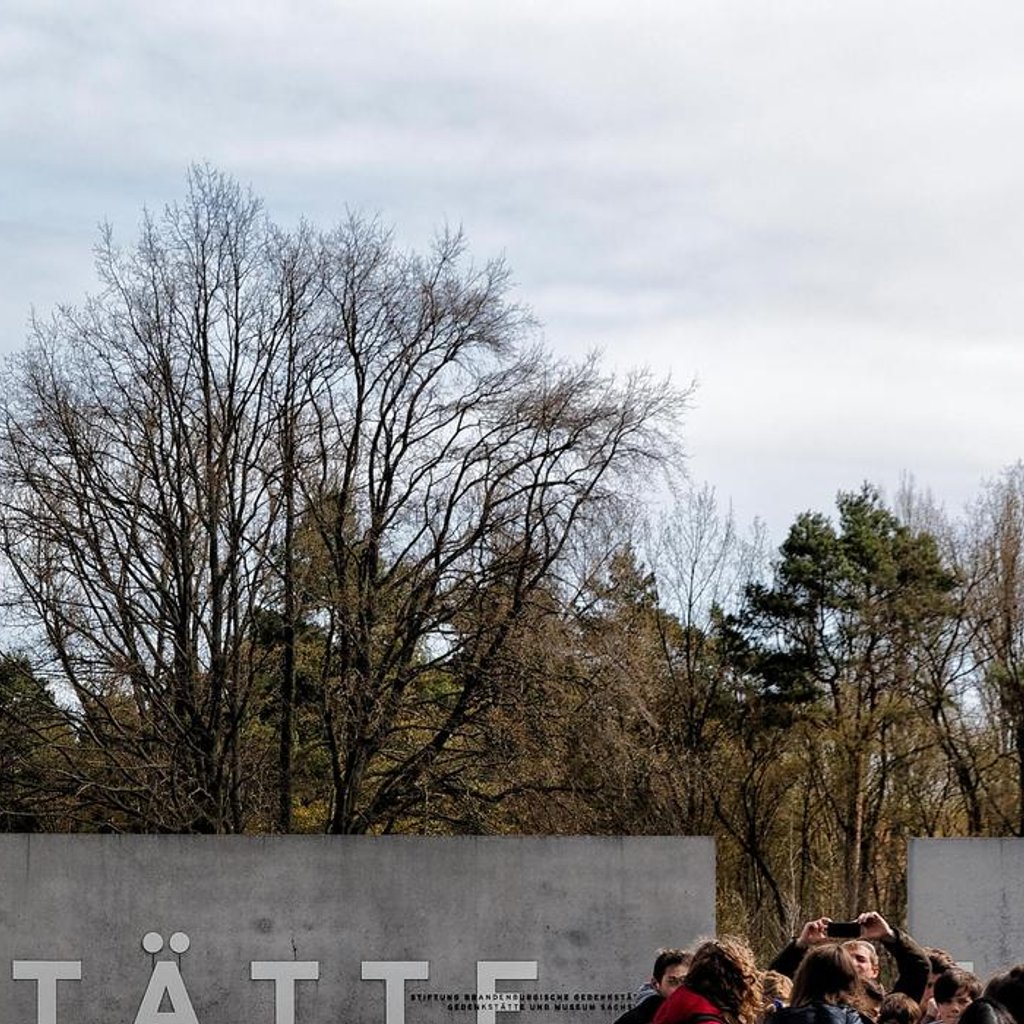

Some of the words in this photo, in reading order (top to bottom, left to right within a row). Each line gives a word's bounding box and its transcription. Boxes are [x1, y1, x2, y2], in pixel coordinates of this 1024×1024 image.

[410, 993, 460, 1001] STIFTUNG
[463, 993, 569, 1001] BRANDENBURGISCHE
[447, 1002, 526, 1011] GEDENKSTÄTTE
[529, 1003, 550, 1011] UND
[554, 1003, 596, 1011] MUSEUM
